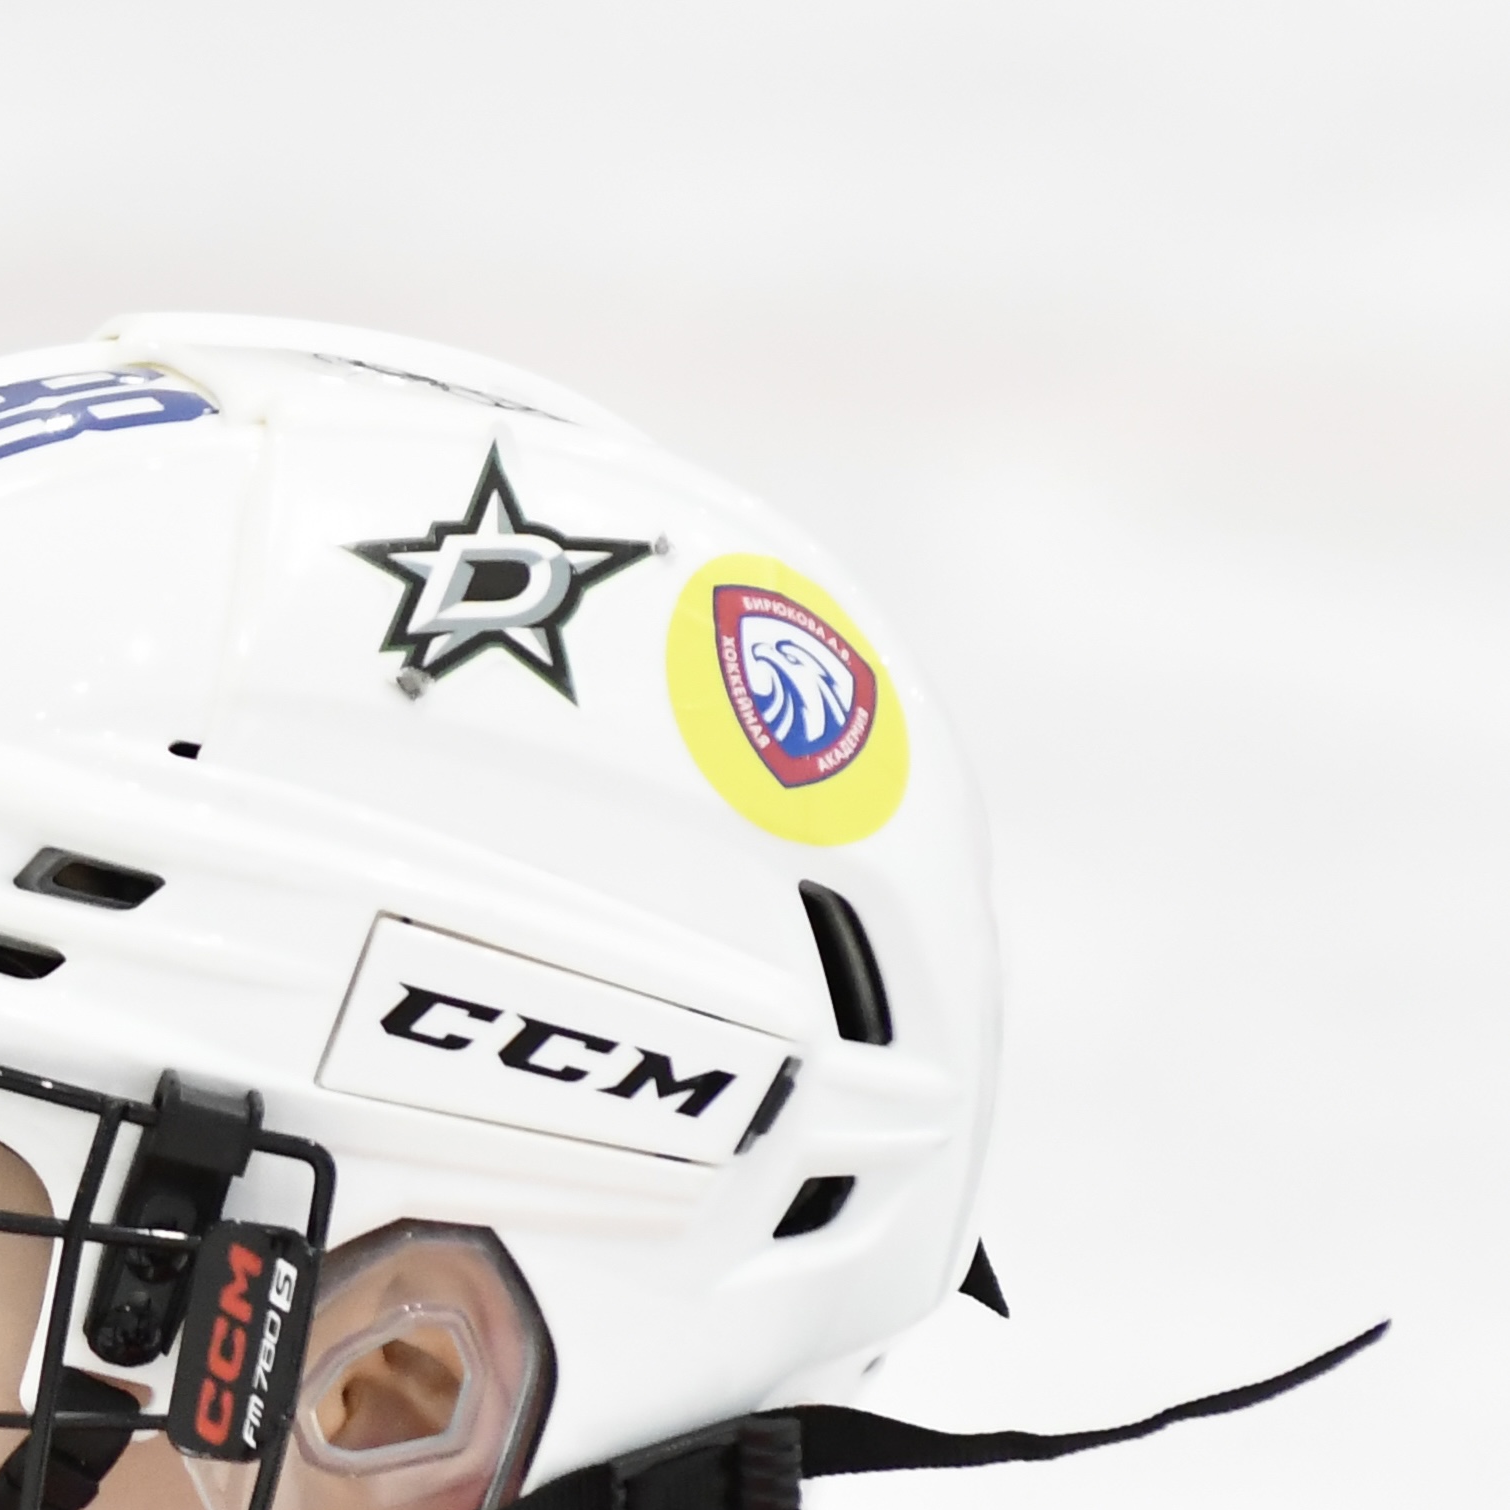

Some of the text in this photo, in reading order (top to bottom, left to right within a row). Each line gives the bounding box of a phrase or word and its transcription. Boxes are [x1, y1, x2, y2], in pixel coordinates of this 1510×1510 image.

[741, 595, 827, 641] БИРЮКОВА
[721, 634, 772, 751] ХОККЕЙНАЯ
[816, 705, 870, 773] АКАДЕМИЯ
[380, 982, 737, 1120] CCM
[194, 1242, 264, 1447] CCM
